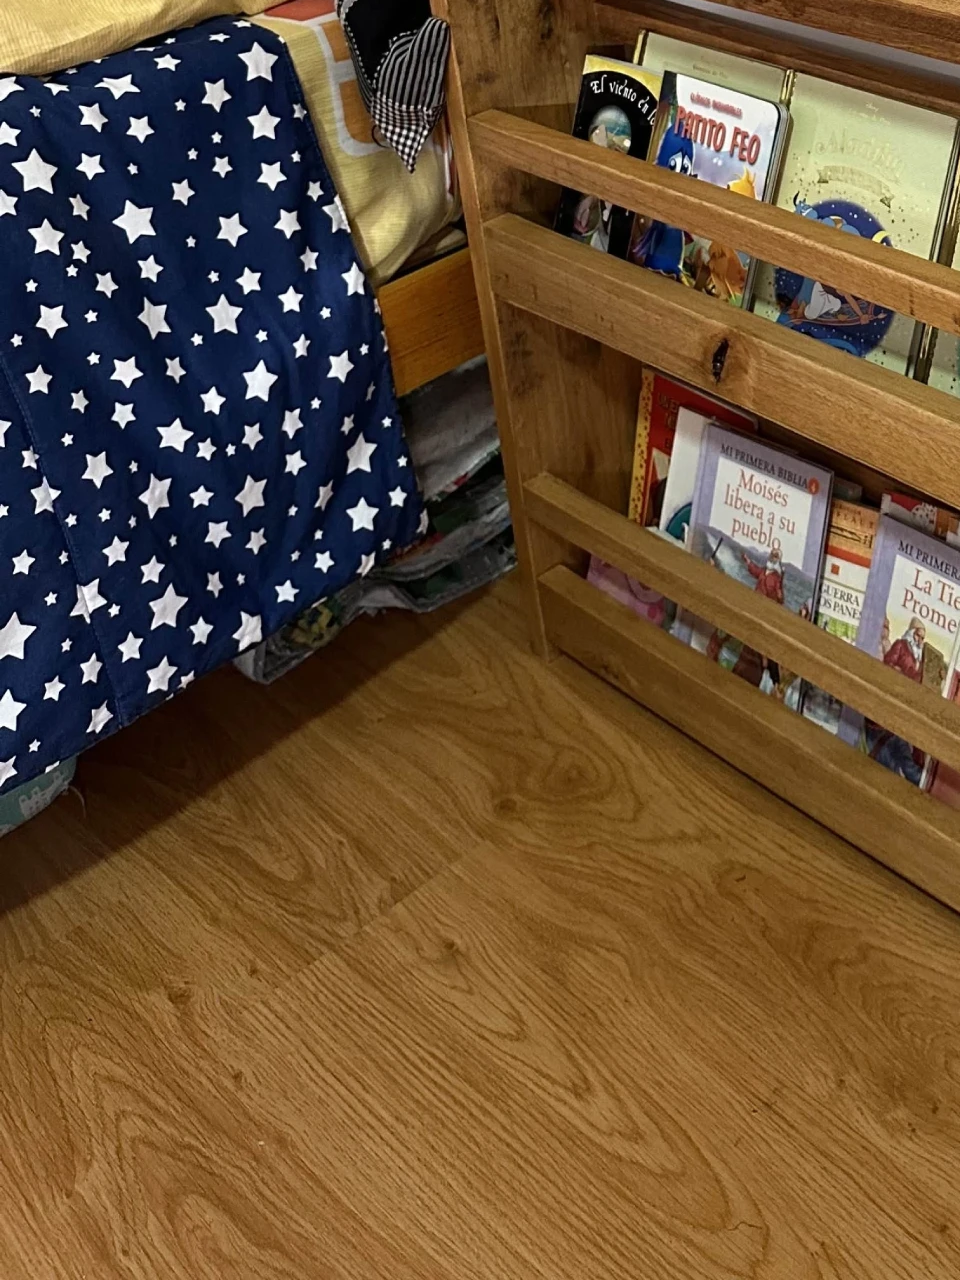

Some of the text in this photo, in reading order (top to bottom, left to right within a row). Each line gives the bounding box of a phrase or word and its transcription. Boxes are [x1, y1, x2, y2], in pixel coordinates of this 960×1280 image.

[589, 74, 607, 94] El
[673, 104, 761, 166] PATITO FEO
[720, 443, 733, 458] MI
[734, 449, 776, 476] PRIMERA
[778, 466, 808, 490] BIBLIA
[738, 469, 789, 508] Moisés
[724, 484, 797, 535] libera a su
[731, 517, 782, 551] pueblo
[898, 540, 914, 558] MI
[912, 568, 932, 596] La
[902, 588, 958, 635] Prome
